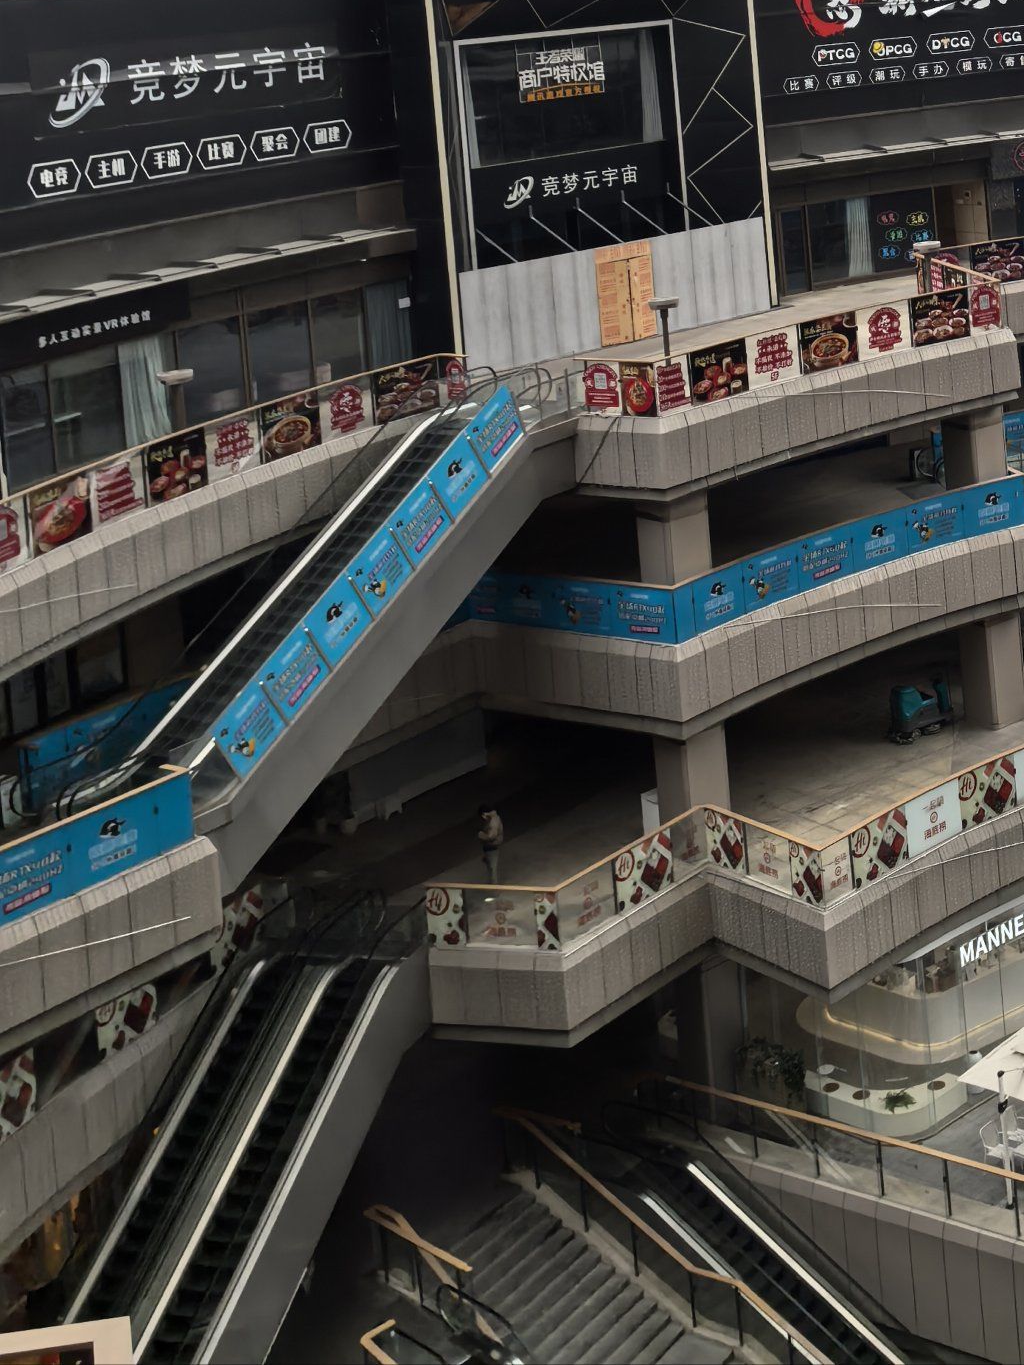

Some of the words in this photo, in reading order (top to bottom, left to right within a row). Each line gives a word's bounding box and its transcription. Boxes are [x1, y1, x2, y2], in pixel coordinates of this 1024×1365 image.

[127, 41, 327, 105] 竞梦元宇宙
[518, 61, 606, 91] 商户特权馆
[789, 79, 814, 91] 比赛
[832, 74, 857, 87] 评级
[875, 69, 900, 82] 潮玩
[918, 64, 943, 77] 手办
[962, 59, 988, 72] 模玩
[39, 166, 69, 188] 电竞
[98, 158, 126, 179] 主机
[153, 149, 181, 170] 手游
[207, 141, 236, 161] 比赛
[261, 133, 289, 153] 聚会
[314, 125, 341, 145] 团建
[541, 164, 638, 197] 竞梦元宇宙
[924, 821, 947, 840] 海底捞
